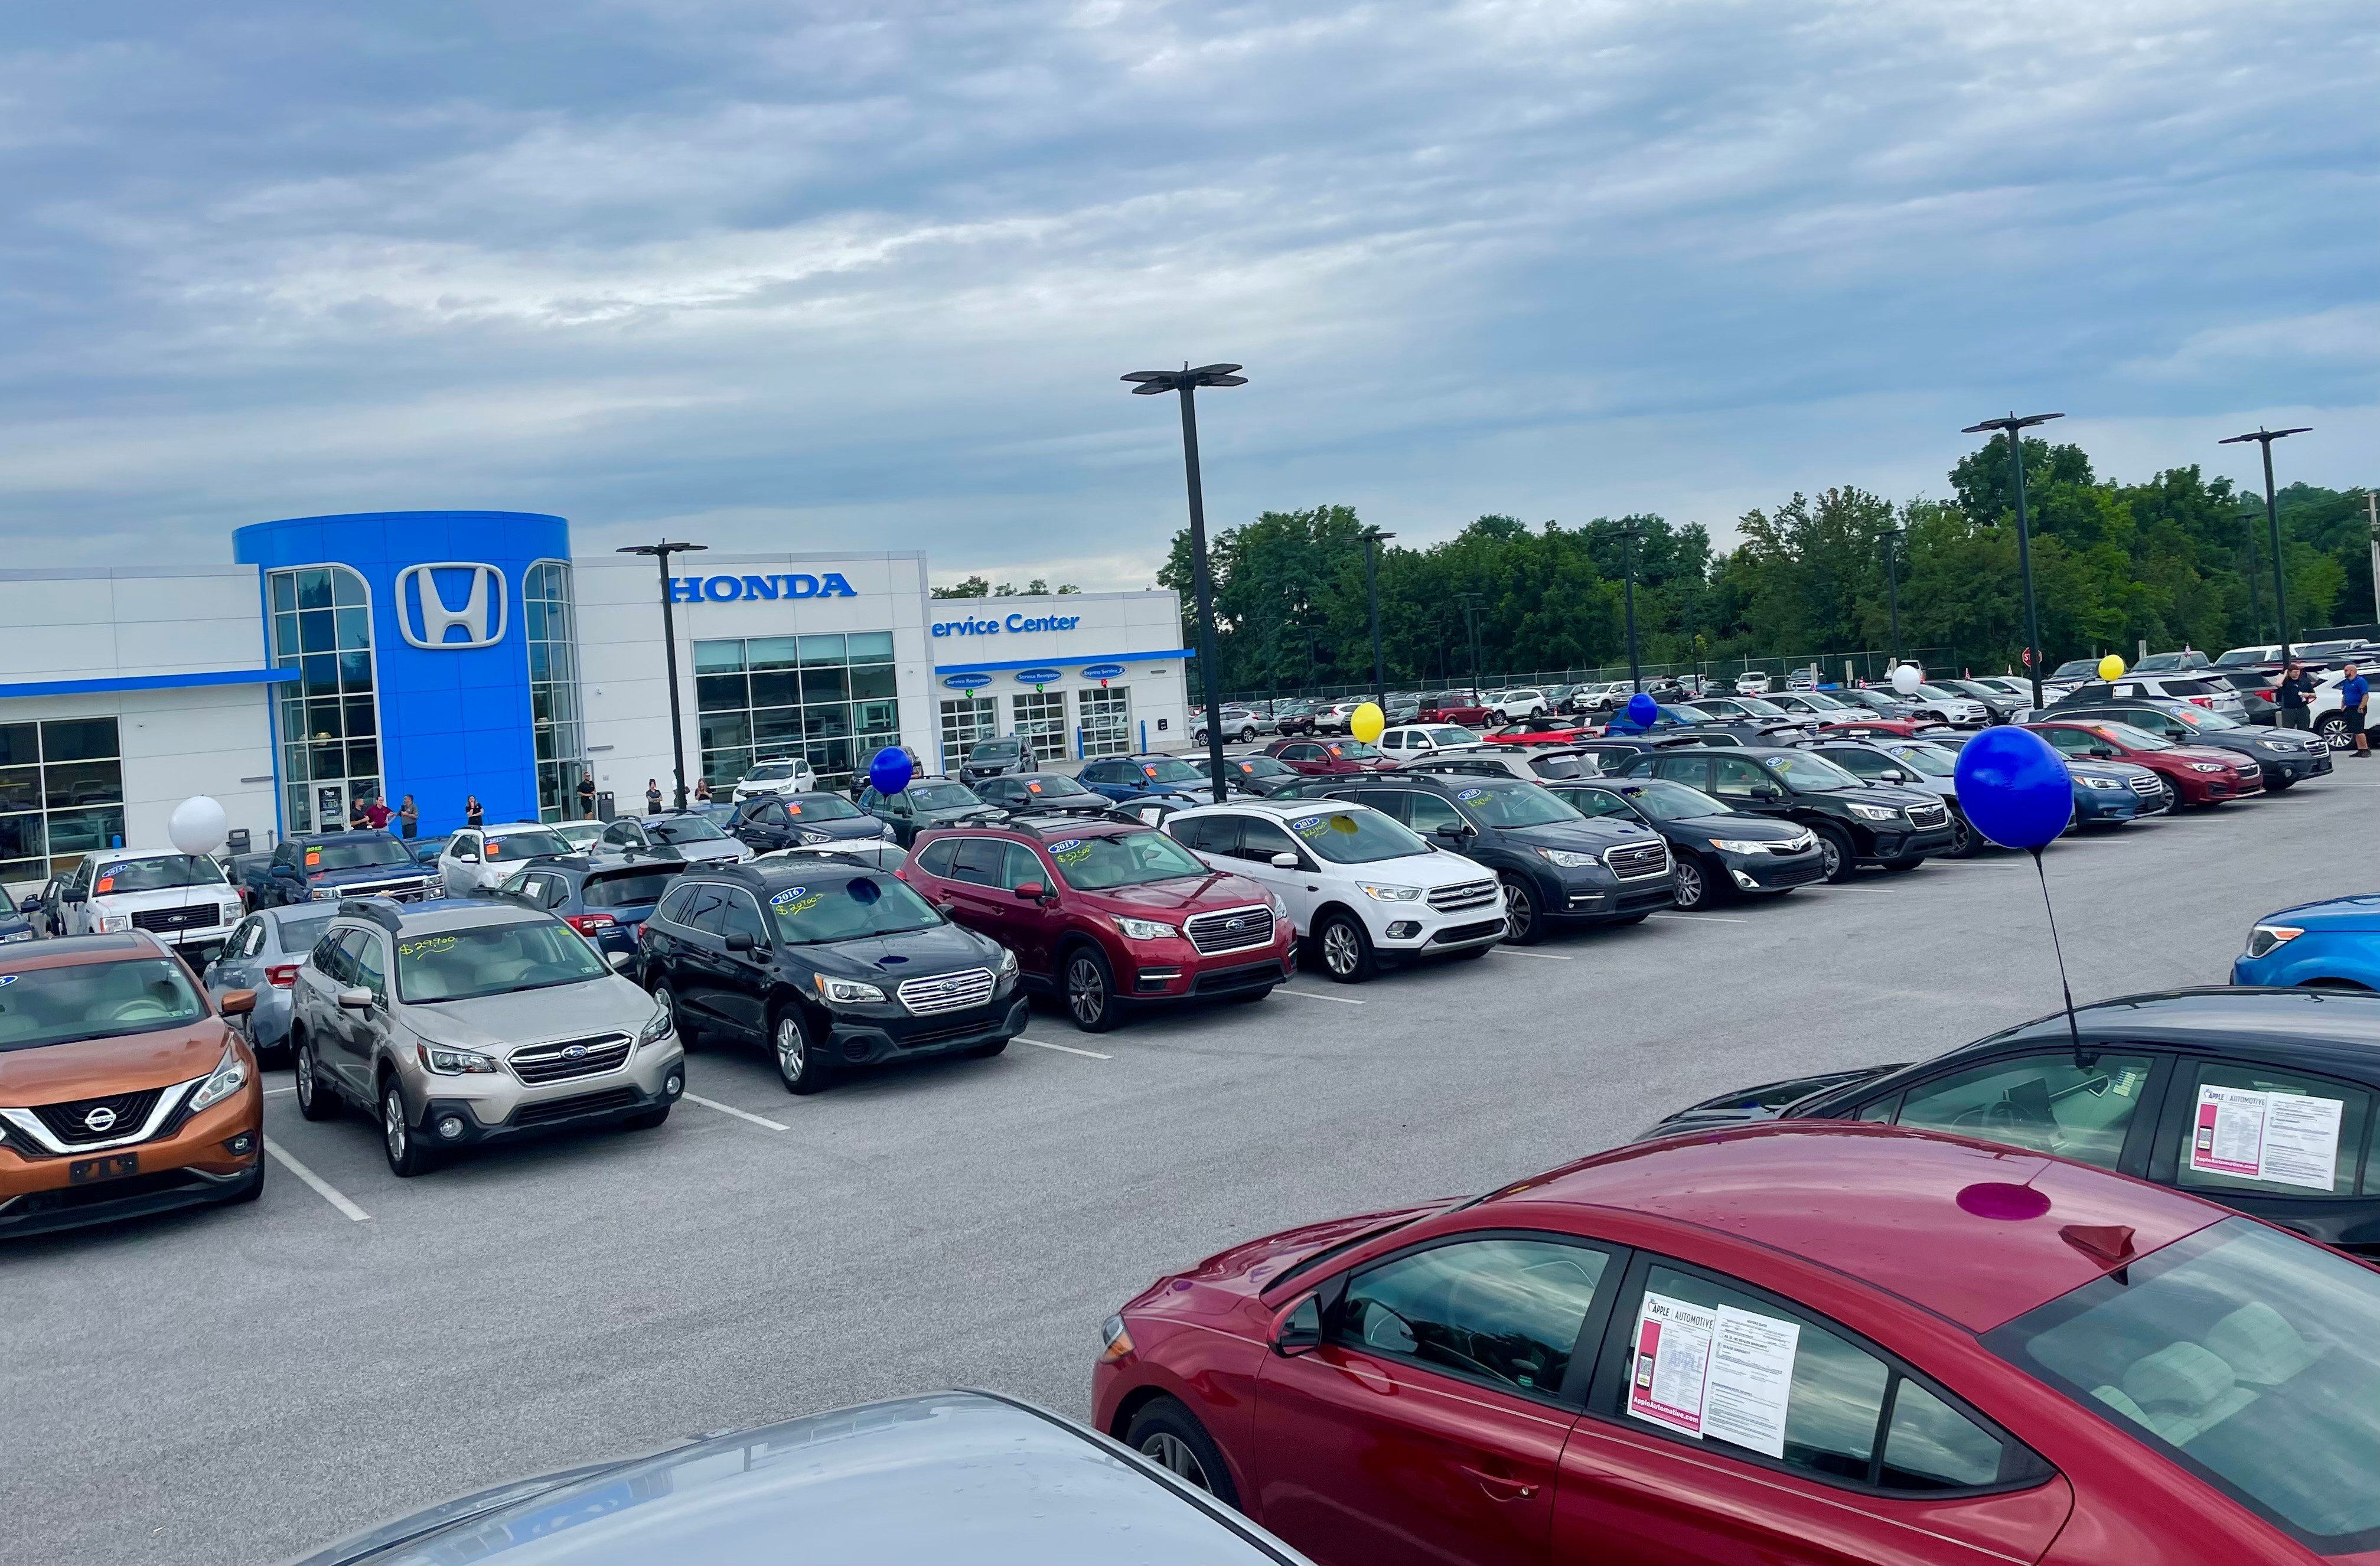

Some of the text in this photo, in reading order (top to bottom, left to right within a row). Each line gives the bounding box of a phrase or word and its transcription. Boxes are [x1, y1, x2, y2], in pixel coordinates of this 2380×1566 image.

[669, 573, 858, 603] HONDA
[931, 613, 1080, 637] ervice Center
[1297, 818, 1314, 828] 2017
[1054, 840, 1074, 852] 2019
[776, 888, 800, 903] 2016
[2208, 1092, 2265, 1106] APPLE AUTOMOTIVE
[2195, 1156, 2257, 1170] AppleAutomotive.com
[1652, 1304, 1670, 1317] APPLE
[1674, 1310, 1713, 1330] AUTOMOTIVE
[1634, 1396, 1698, 1424] AppleAutomotive.com
